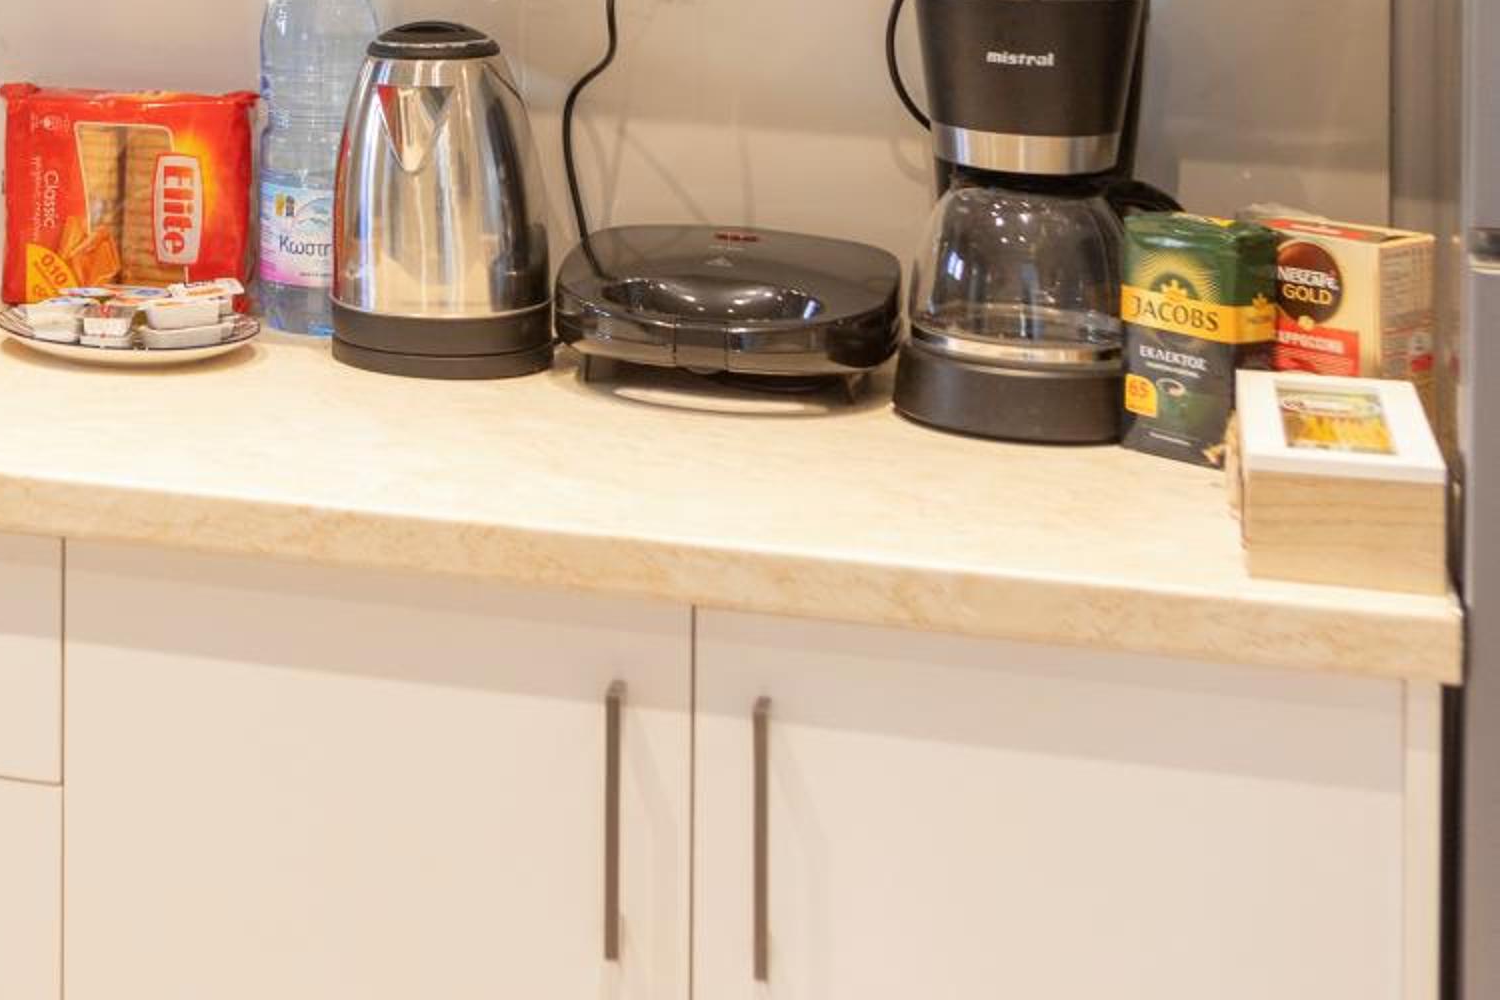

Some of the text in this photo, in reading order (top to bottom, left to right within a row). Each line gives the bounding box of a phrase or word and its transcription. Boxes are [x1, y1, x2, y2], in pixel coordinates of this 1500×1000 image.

[986, 51, 1055, 67] mistral
[43, 169, 59, 229] Classic
[163, 166, 196, 255] Elite
[1283, 283, 1333, 305] GOLD
[1129, 295, 1220, 332] JACOBS
